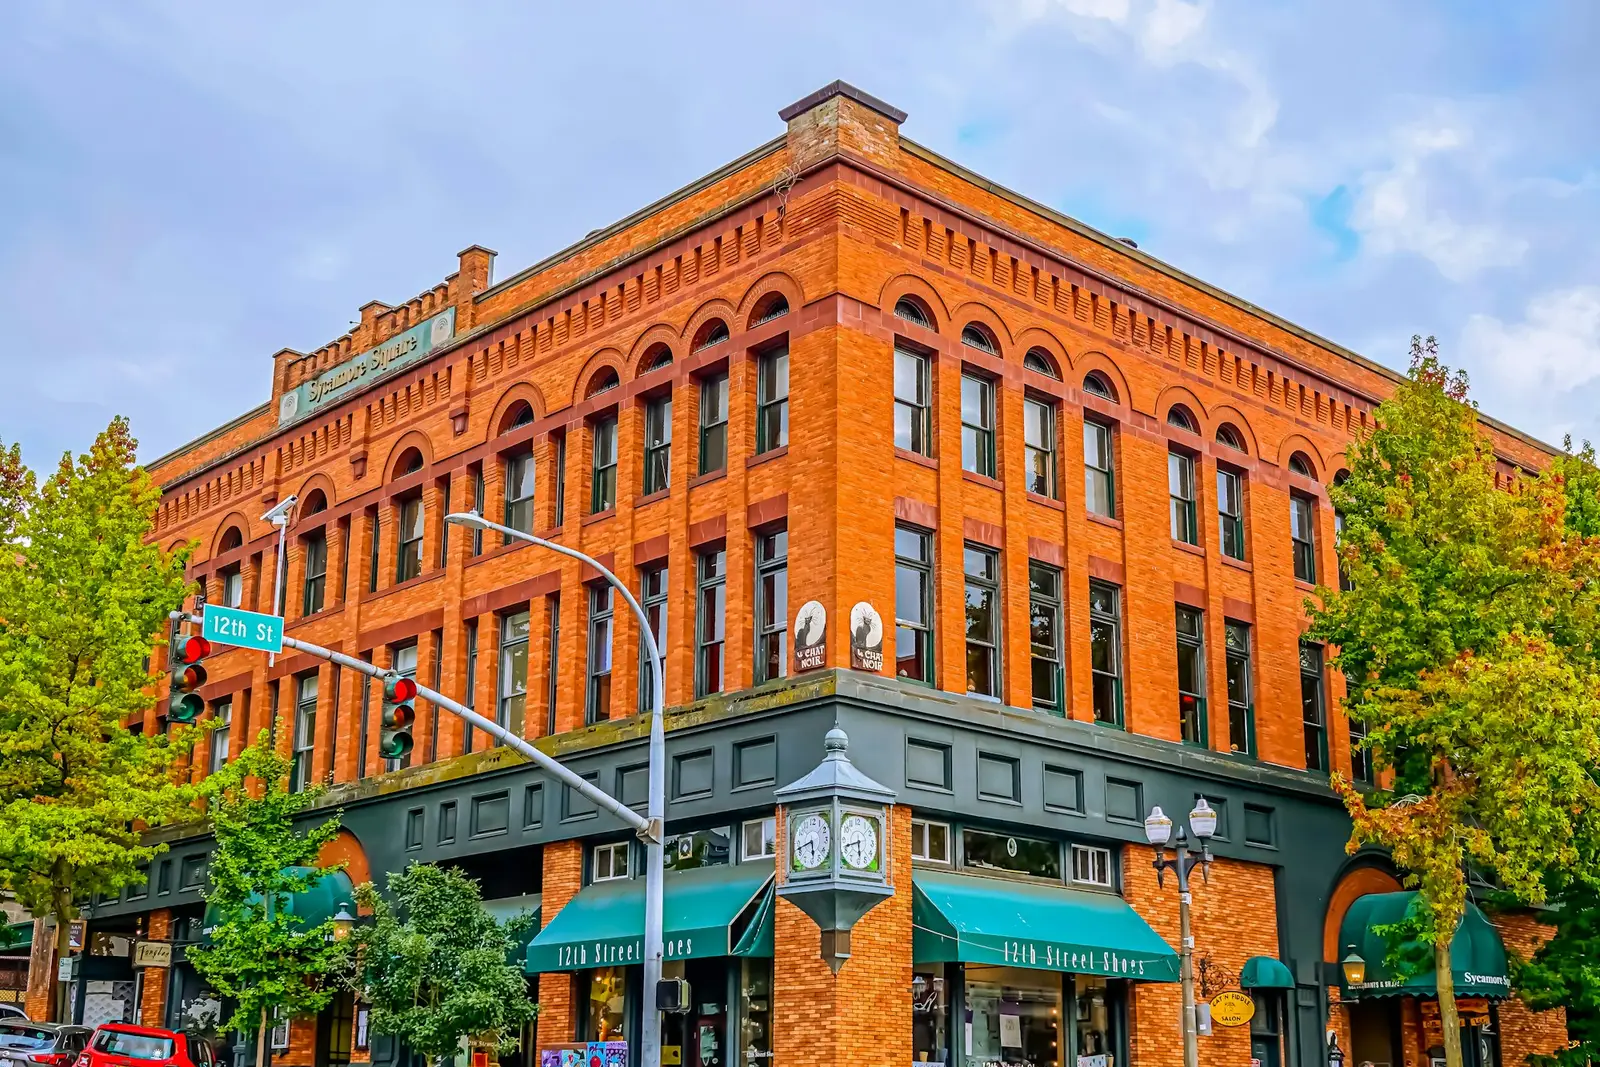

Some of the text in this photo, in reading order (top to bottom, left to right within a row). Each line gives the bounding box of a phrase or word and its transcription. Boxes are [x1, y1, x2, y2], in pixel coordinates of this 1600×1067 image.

[309, 336, 418, 403] Sycamore Square
[213, 615, 274, 643] 12th St
[804, 645, 825, 658] CHAT
[801, 656, 825, 669] NOIR
[862, 658, 883, 672] NOIR
[558, 938, 692, 966] 12th Street oes
[1004, 941, 1144, 975] 12th Street Shoes
[1464, 971, 1503, 985] Sycamore
[1232, 993, 1250, 1006] FIDDLE
